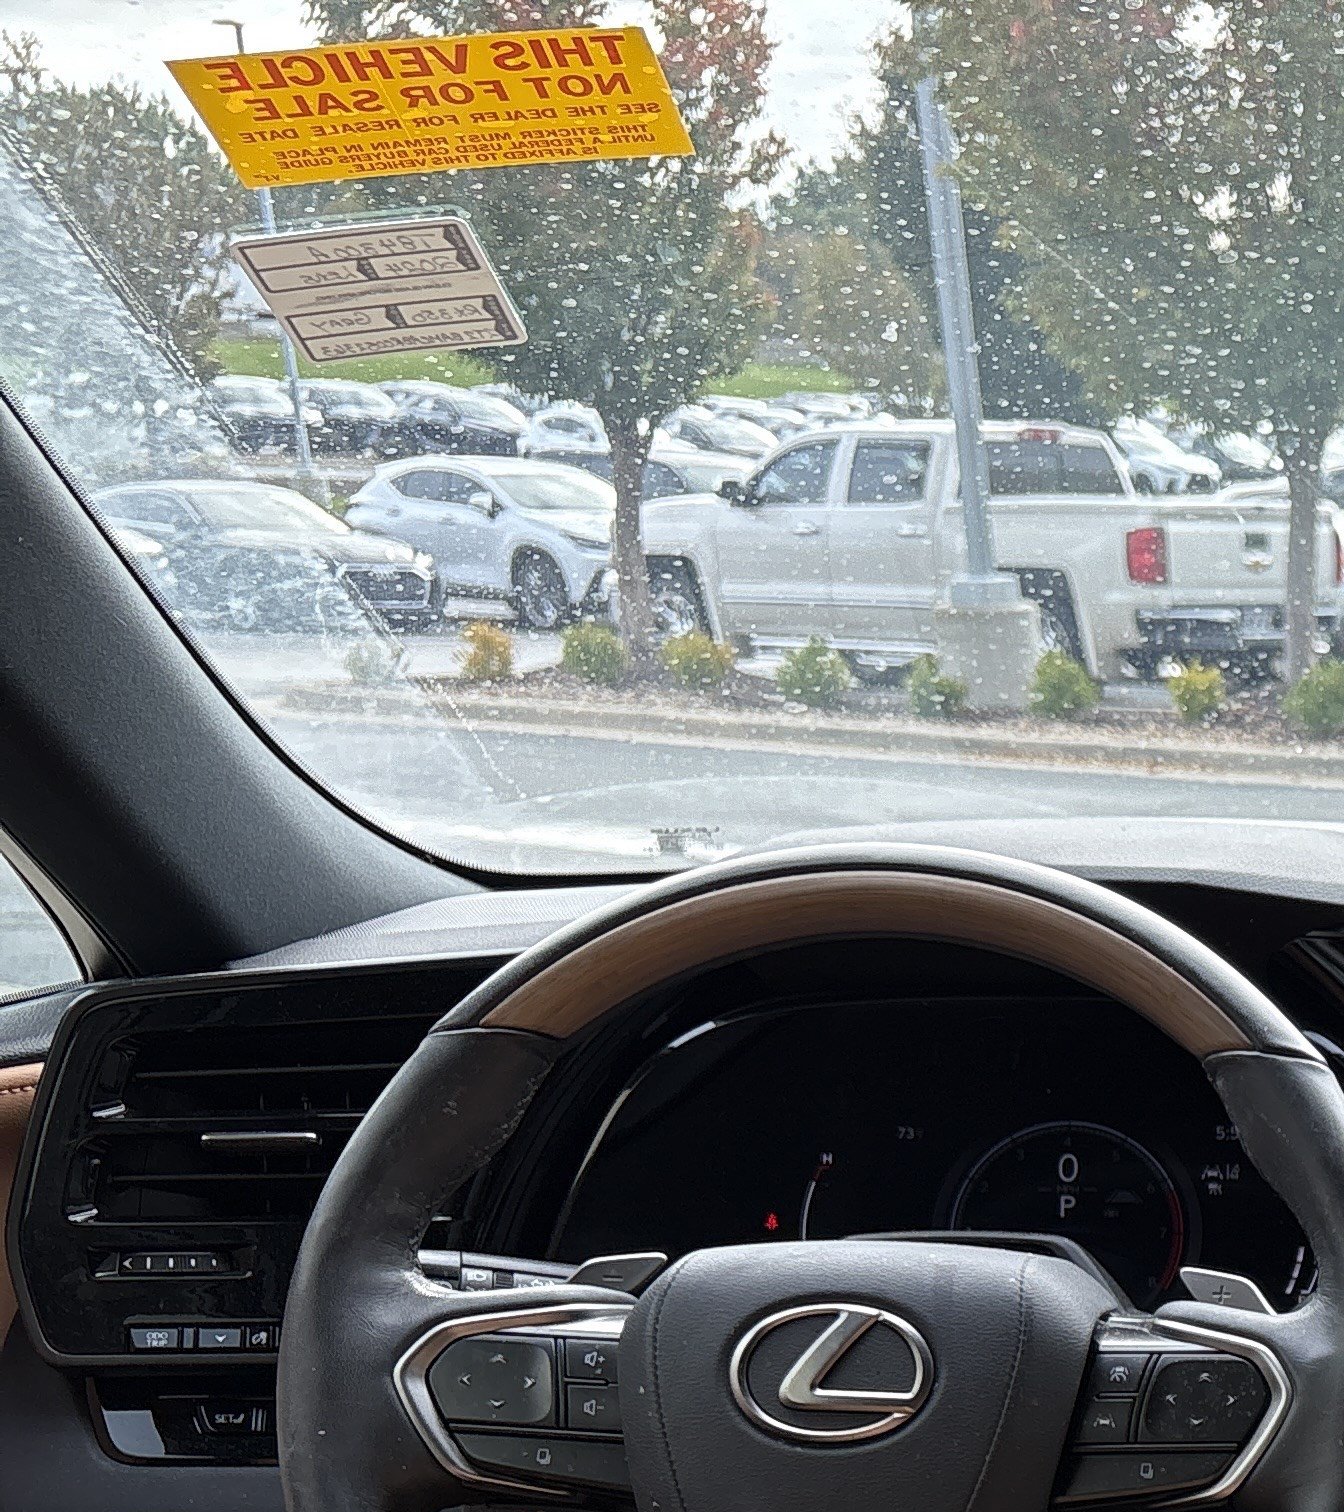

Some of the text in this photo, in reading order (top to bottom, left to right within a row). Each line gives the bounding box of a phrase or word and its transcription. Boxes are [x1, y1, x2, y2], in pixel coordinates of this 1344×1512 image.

[1059, 1194, 1077, 1219] P
[145, 1331, 169, 1340] ODO
[214, 1413, 235, 1424] SET
